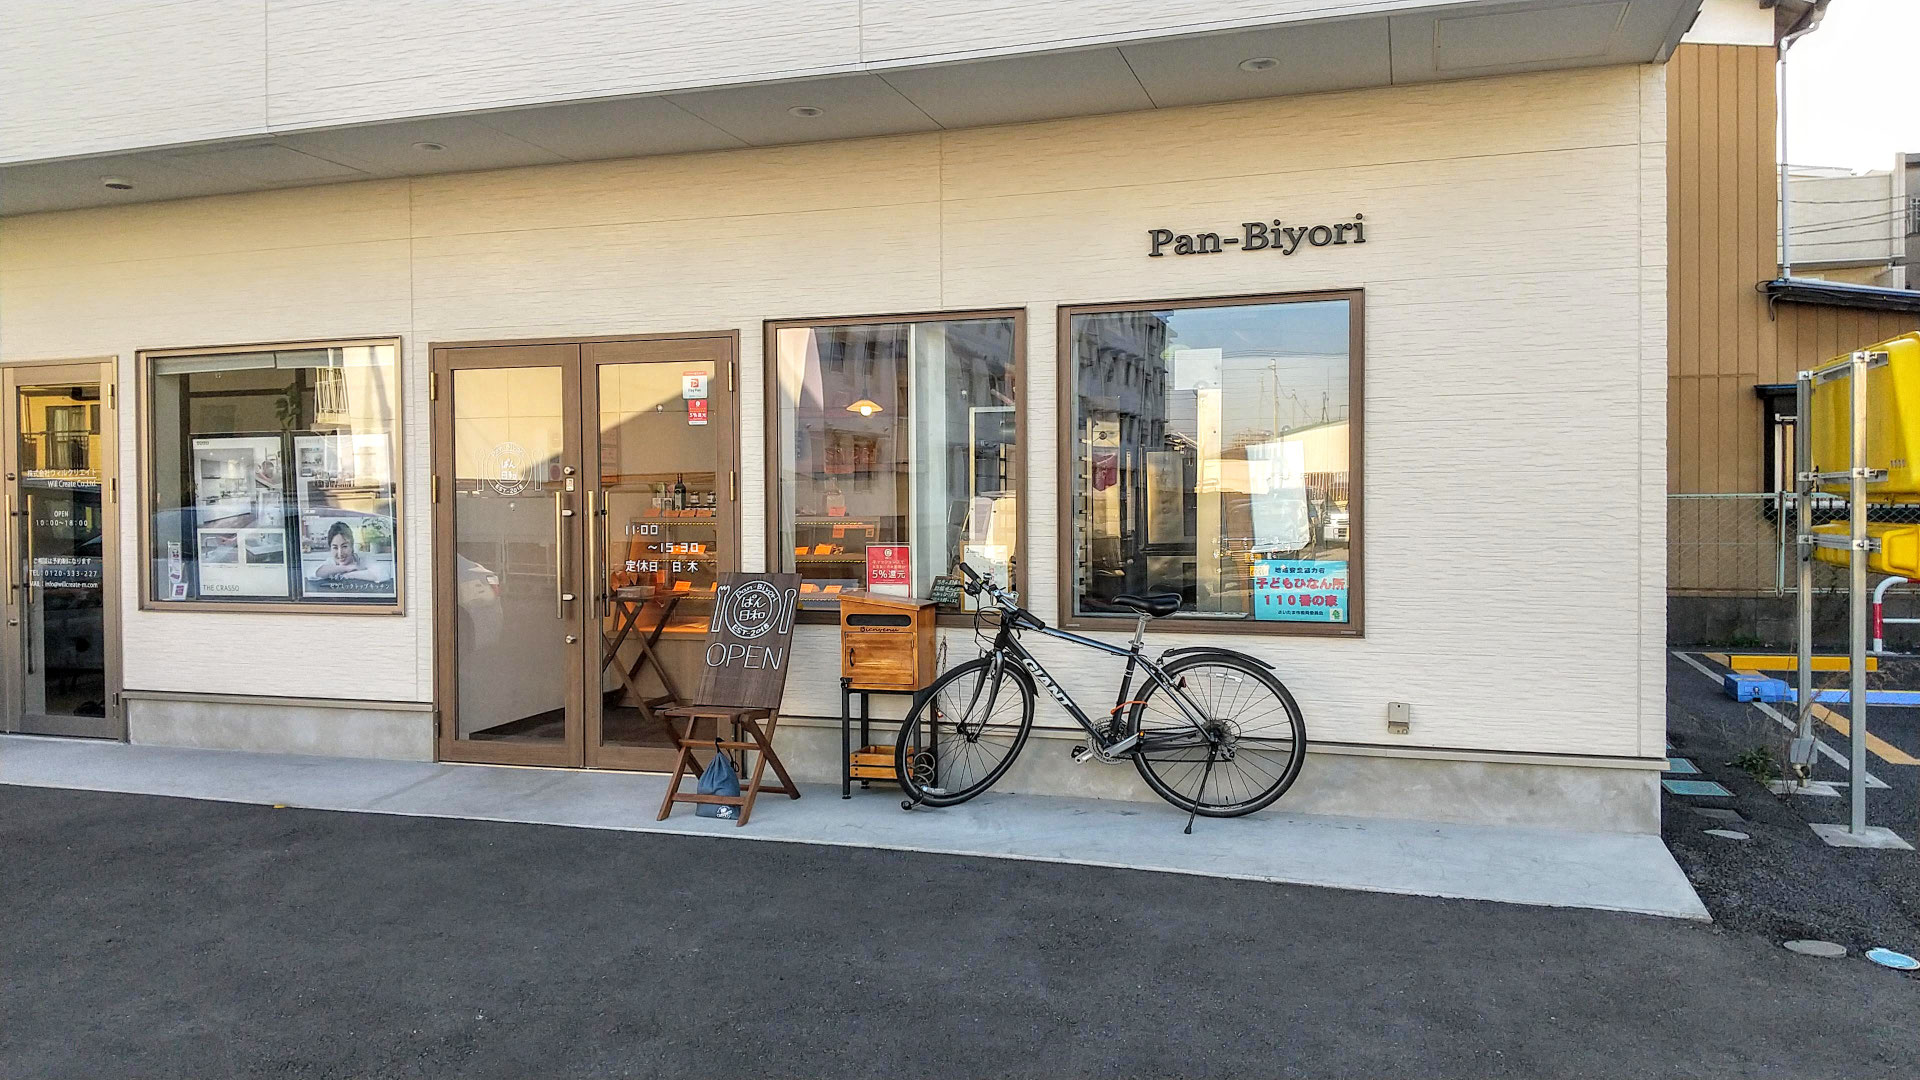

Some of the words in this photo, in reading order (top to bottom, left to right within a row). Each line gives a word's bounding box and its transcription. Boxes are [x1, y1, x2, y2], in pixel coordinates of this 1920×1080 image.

[1148, 213, 1366, 257] Pan-Biyori
[58, 480, 76, 488] Create
[53, 510, 69, 518] OPEN
[625, 524, 658, 535] 11:00
[625, 560, 658, 572] 定休日
[203, 584, 213, 592] THE
[215, 584, 240, 592] CRASSO
[1256, 577, 1345, 590] 子どもひなん所
[741, 594, 766, 608] ぱん
[1264, 594, 1338, 607] 110番の家
[739, 609, 766, 621] 日和
[731, 622, 770, 637] EST-2018
[706, 642, 783, 670] OPEN
[1022, 658, 1074, 707] GIANT
